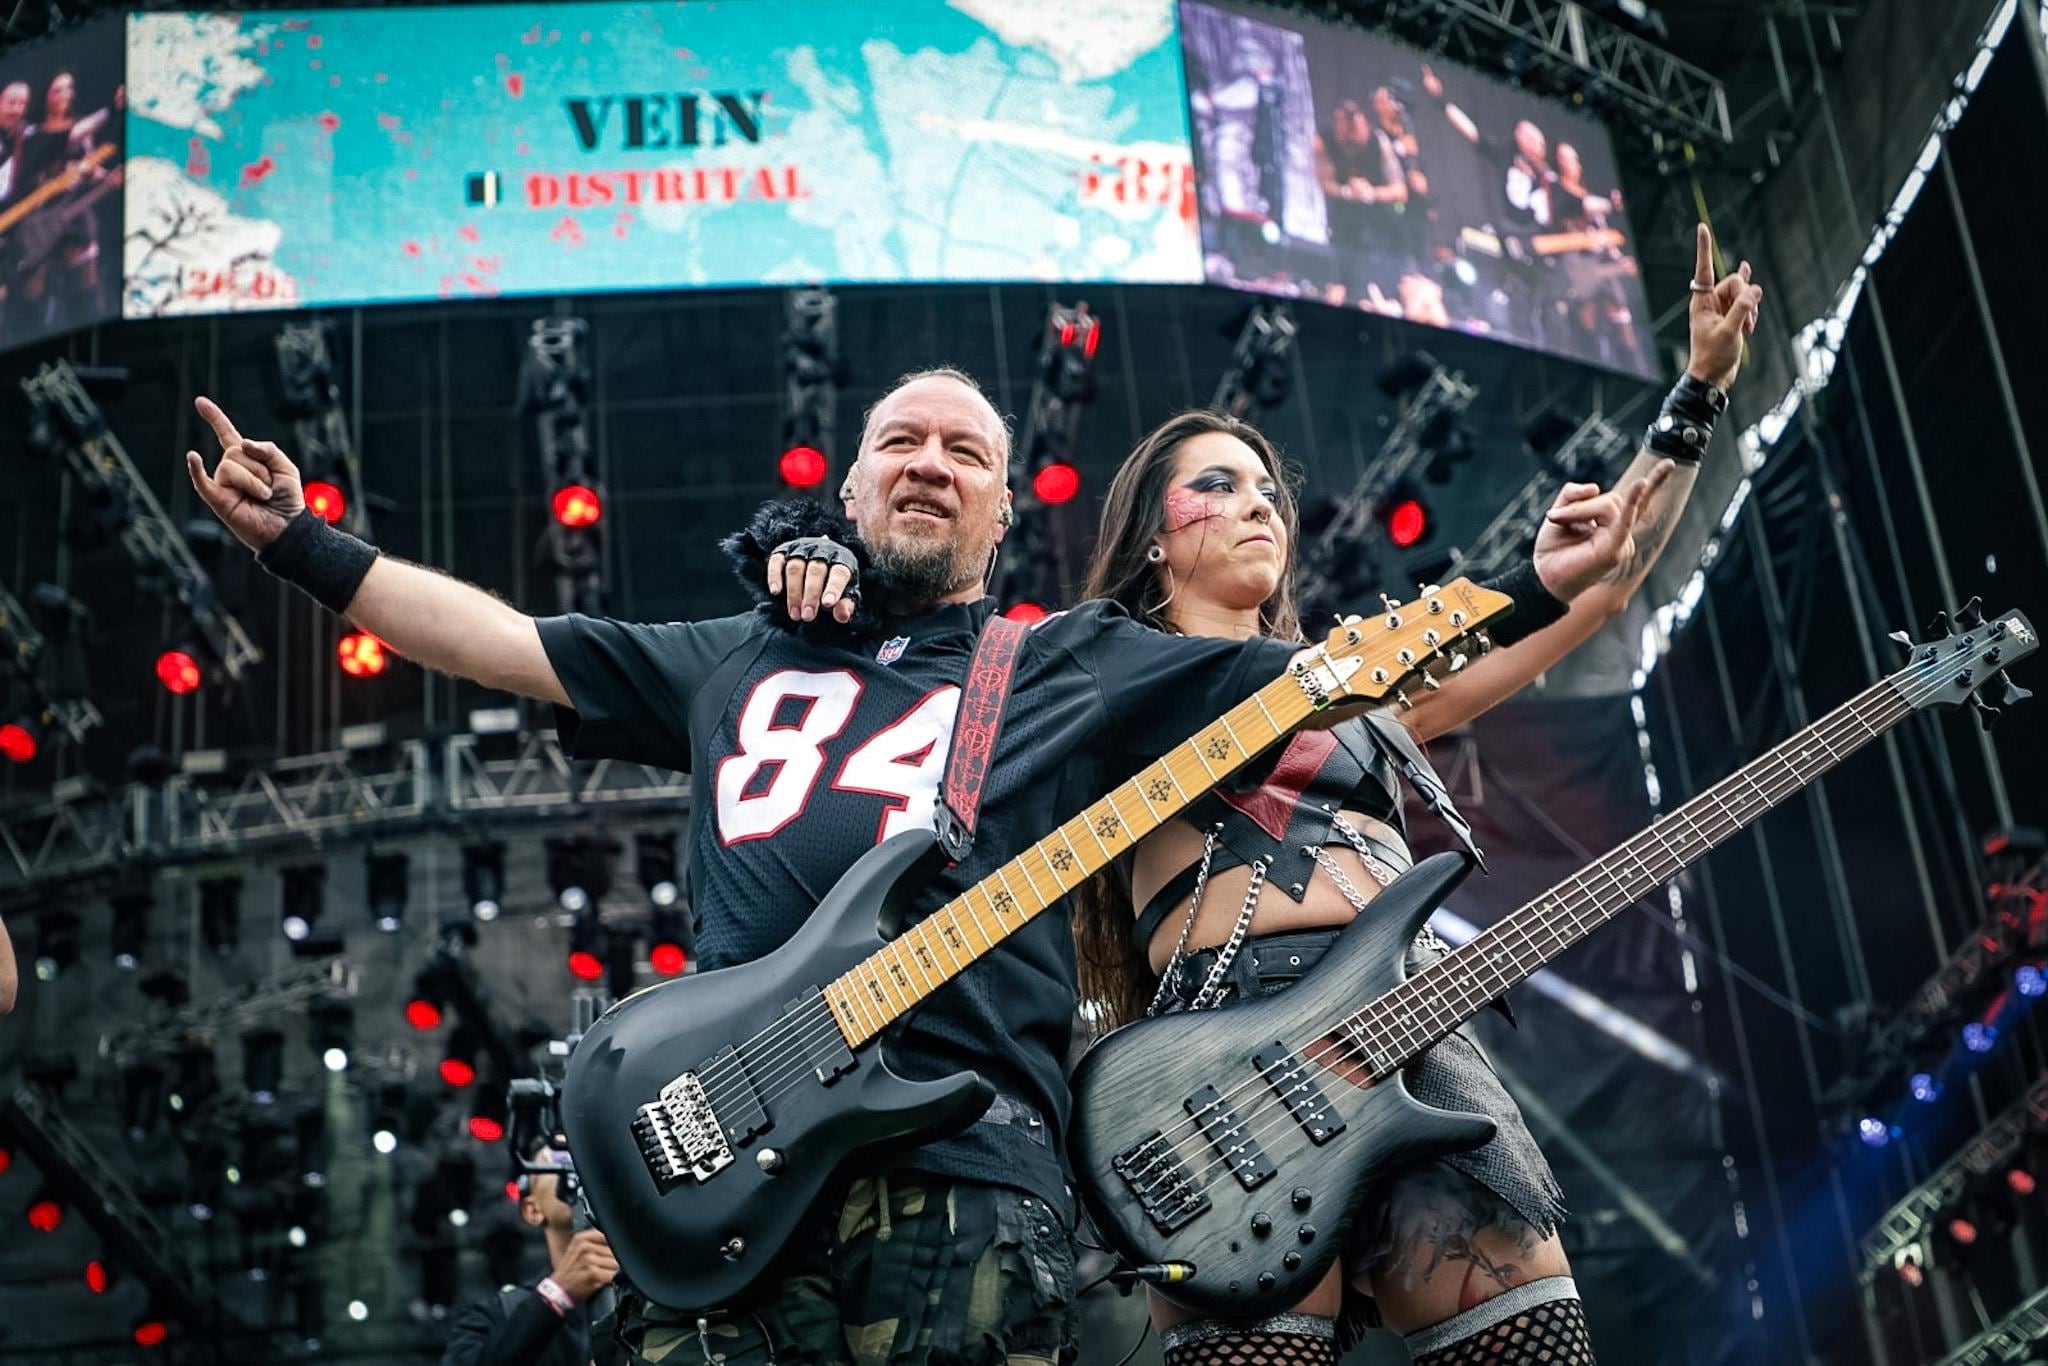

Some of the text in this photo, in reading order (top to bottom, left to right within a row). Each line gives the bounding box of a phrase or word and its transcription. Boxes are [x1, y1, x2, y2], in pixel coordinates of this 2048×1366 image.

[564, 88, 767, 151] VEIN
[526, 164, 811, 207] DISTRITAL
[715, 668, 962, 848] 84
